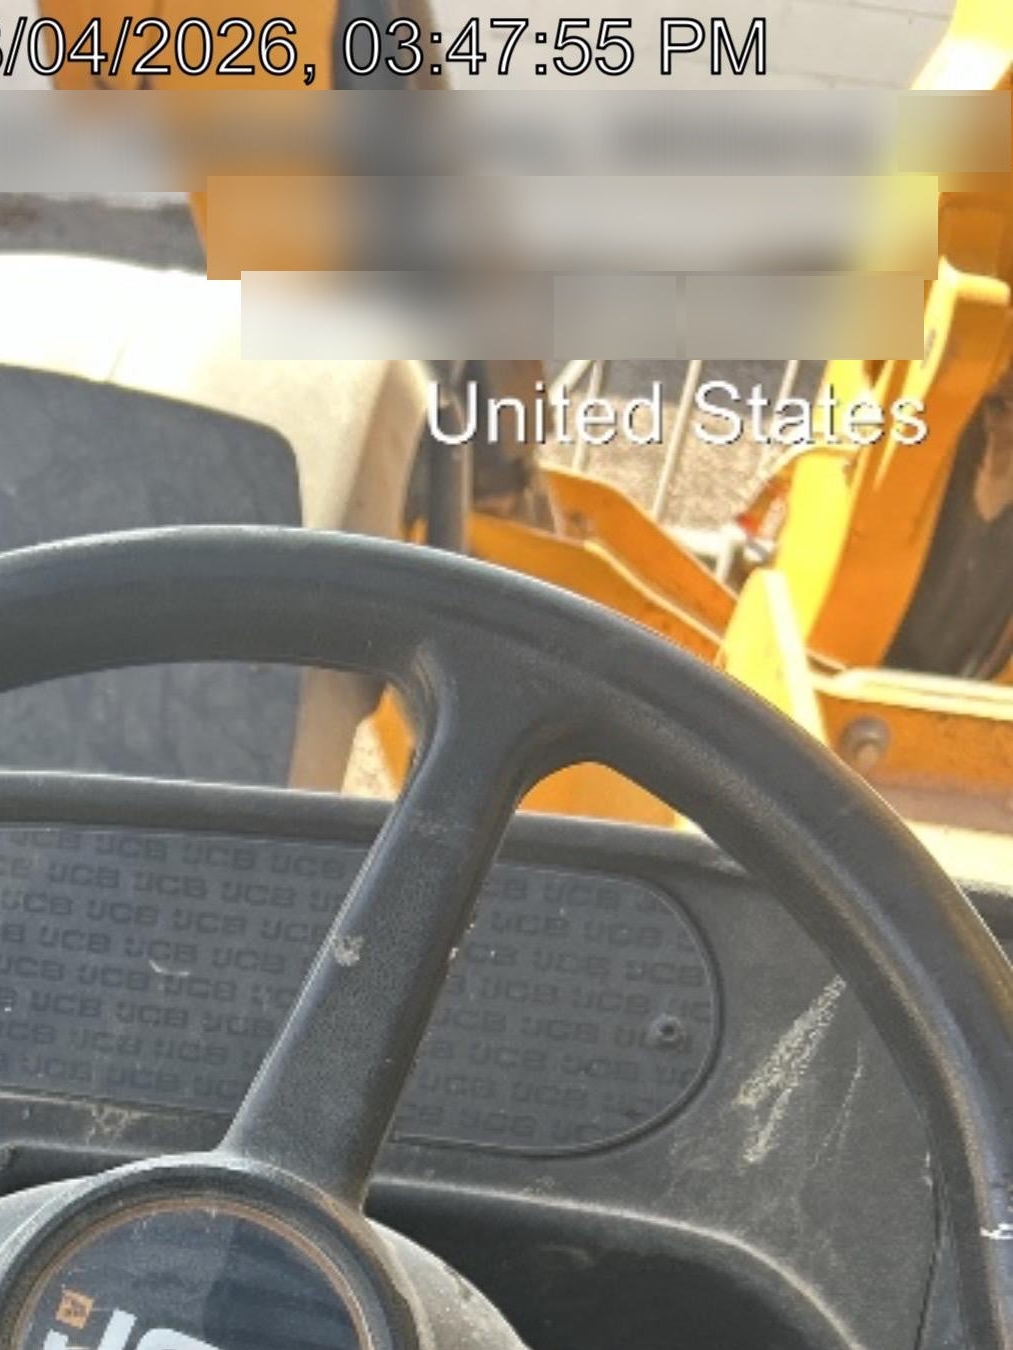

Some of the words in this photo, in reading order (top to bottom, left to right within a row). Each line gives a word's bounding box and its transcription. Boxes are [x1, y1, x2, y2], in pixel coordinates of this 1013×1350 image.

[48, 862, 120, 889] JCB
[134, 871, 208, 899] JCB
[221, 881, 296, 908] JCB
[491, 911, 570, 937] JCB
[585, 920, 663, 948] JCB
[95, 833, 167, 862] JCB
[182, 842, 256, 870] JCB
[271, 853, 346, 881] JCB
[543, 878, 620, 909] JCB
[1, 889, 73, 915] JCB
[87, 899, 159, 926] JCB
[172, 908, 247, 936] JCB
[533, 951, 611, 977] JCB
[625, 960, 705, 987] JCB
[40, 926, 111, 954] JCB
[124, 937, 198, 964] JCB
[211, 948, 286, 975] JCB
[482, 977, 558, 1005] JCB
[571, 986, 650, 1015] JCB
[31, 991, 101, 1018] JCB
[116, 1001, 188, 1028] JCB
[202, 1012, 276, 1038] JCB
[469, 1042, 546, 1071] JCB
[79, 964, 150, 991] JCB
[164, 974, 237, 1001] JCB
[520, 1016, 599, 1044] JCB
[22, 1054, 92, 1081] JCB
[107, 1064, 179, 1092] JCB
[70, 1027, 141, 1055] JCB
[155, 1039, 228, 1065] JCB
